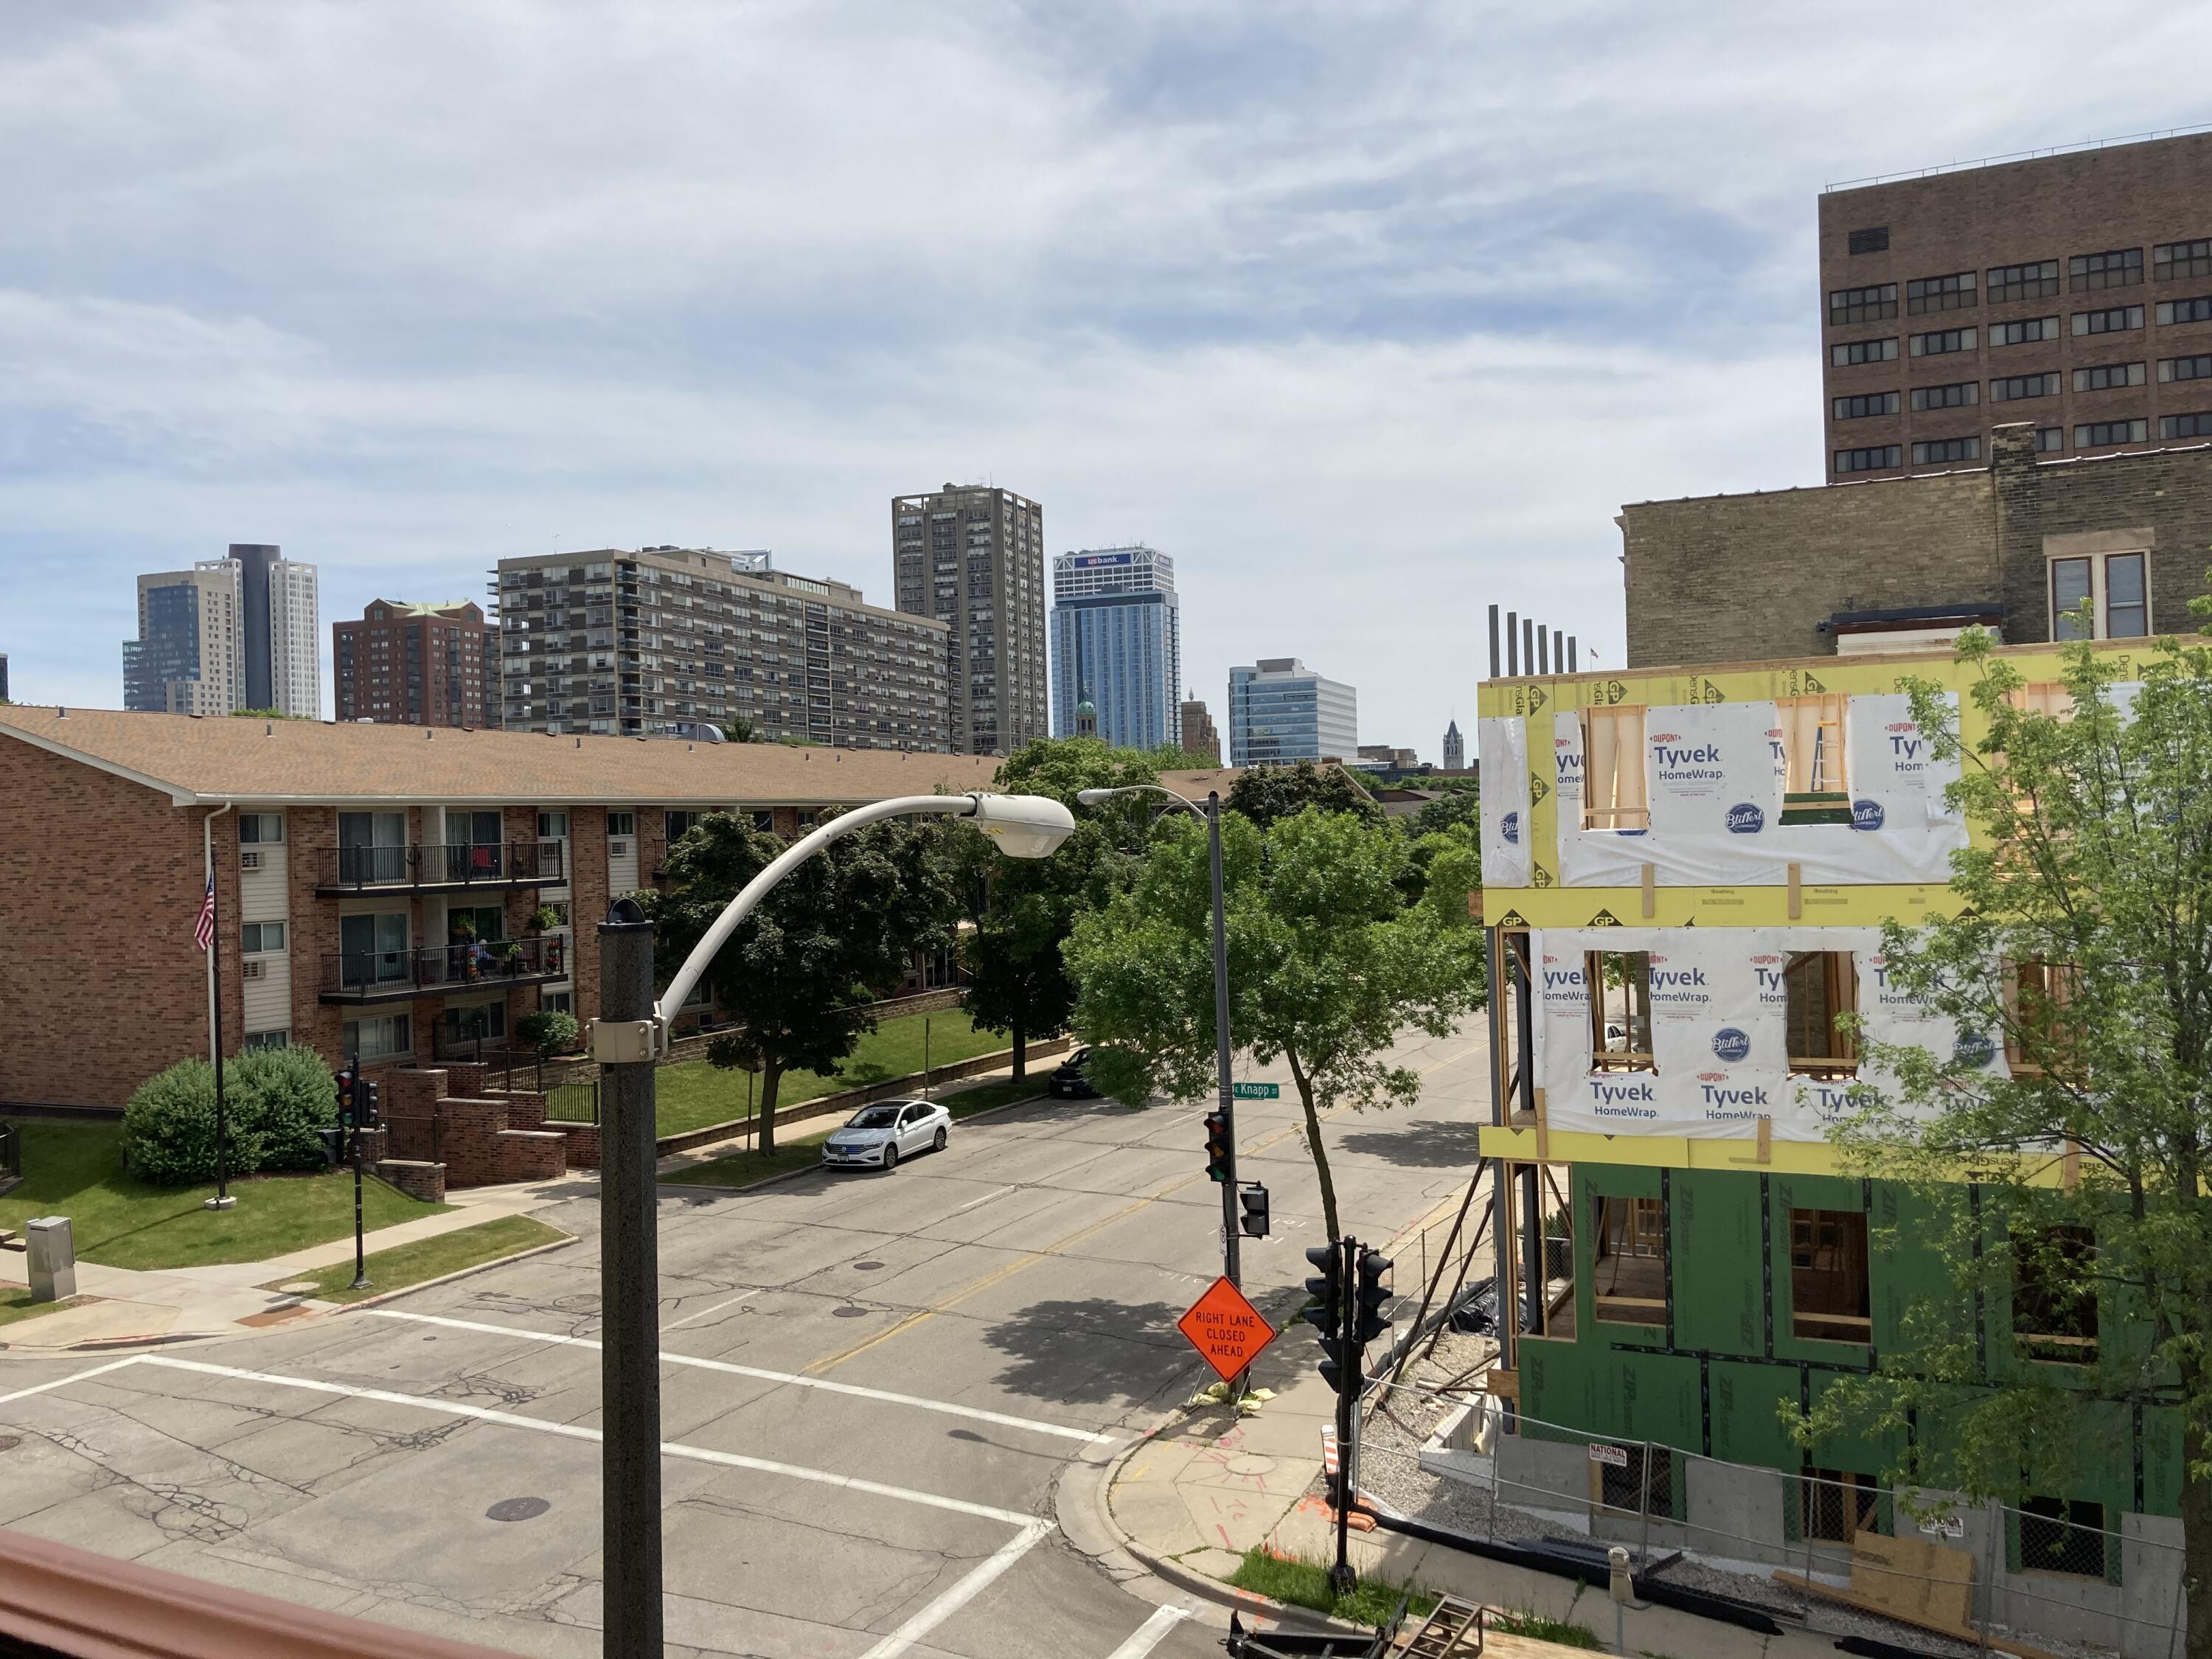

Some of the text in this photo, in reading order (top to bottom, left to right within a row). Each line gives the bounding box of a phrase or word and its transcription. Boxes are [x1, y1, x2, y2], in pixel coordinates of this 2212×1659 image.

[1531, 688, 1541, 708] GP
[1889, 723, 1916, 732] DUPONT
[1653, 734, 1677, 742] DUPONT
[1654, 744, 1719, 768] Tyvek
[1659, 769, 1722, 780] HomeWrap
[1533, 779, 1543, 799] GP
[1535, 869, 1545, 888] GP
[1502, 917, 1523, 926] GP
[1594, 917, 1615, 926] GP
[1753, 955, 1780, 964] DUPONT
[1649, 967, 1705, 990] Tyvek
[1700, 1072, 1725, 1082] DUPONT
[1241, 1083, 1269, 1097] Knapp
[1590, 1082, 1654, 1105] Tyvek
[1701, 1085, 1767, 1108] Tyvek
[1595, 1106, 1657, 1119] HomeWrap
[1196, 1312, 1255, 1327] RIGHT LANE
[1206, 1328, 1245, 1342] CLOSED
[1211, 1344, 1243, 1357] AHEAD
[1591, 1444, 1625, 1458] NATIONAL
